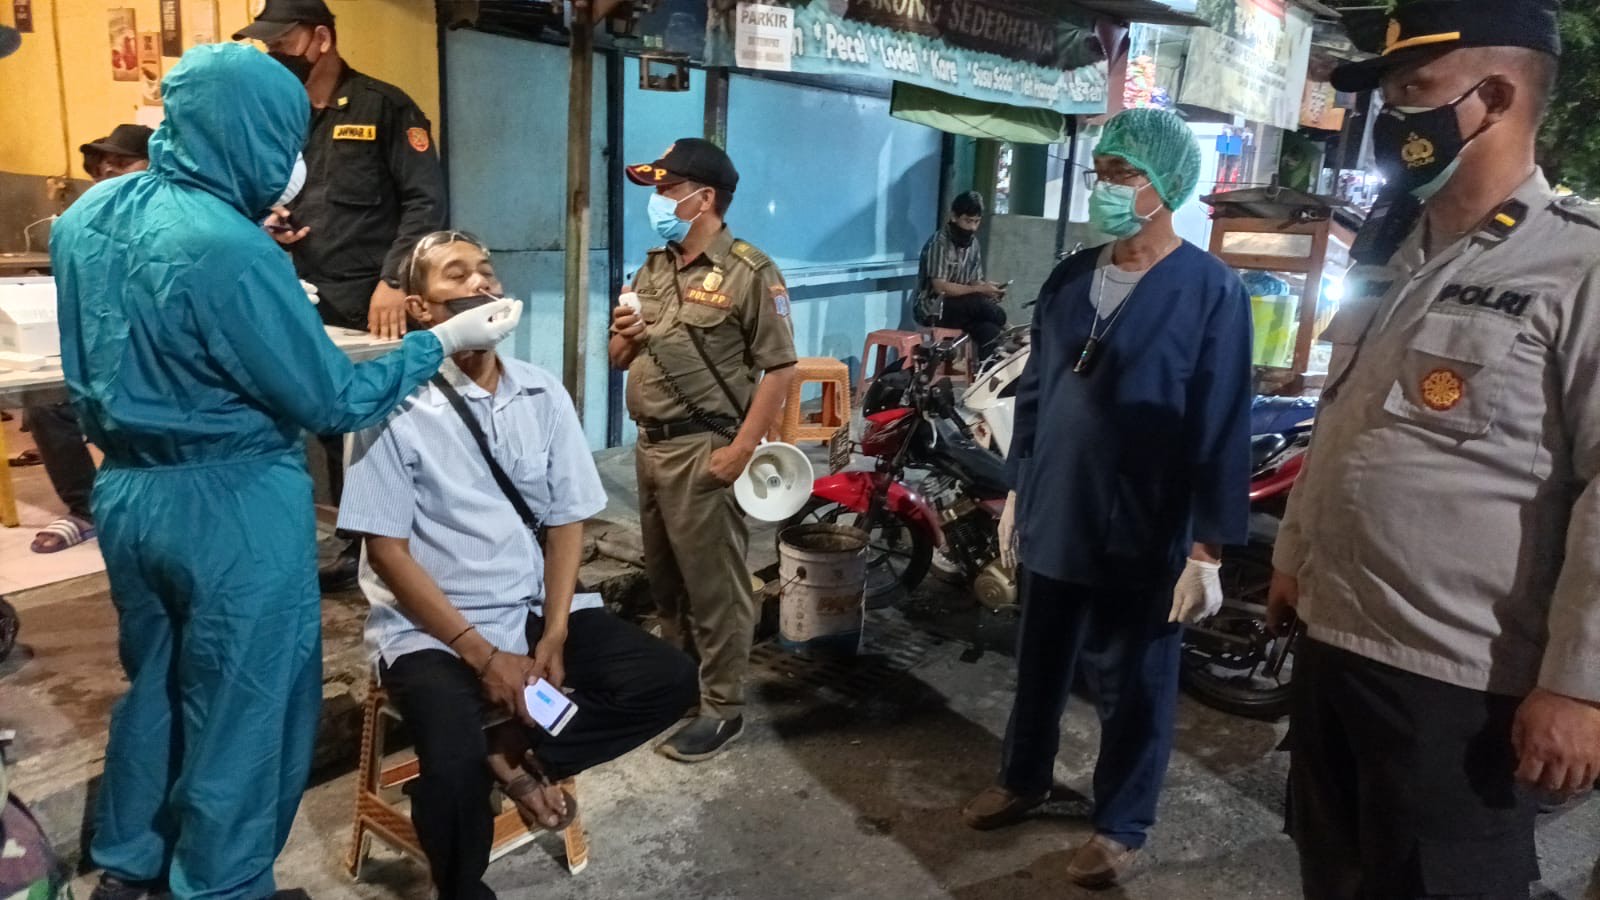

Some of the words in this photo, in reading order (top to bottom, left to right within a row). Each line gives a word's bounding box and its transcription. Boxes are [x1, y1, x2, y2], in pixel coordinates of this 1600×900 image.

[740, 10, 788, 29] PARKIR
[710, 293, 726, 304] PP
[1438, 284, 1533, 317] POLRI
